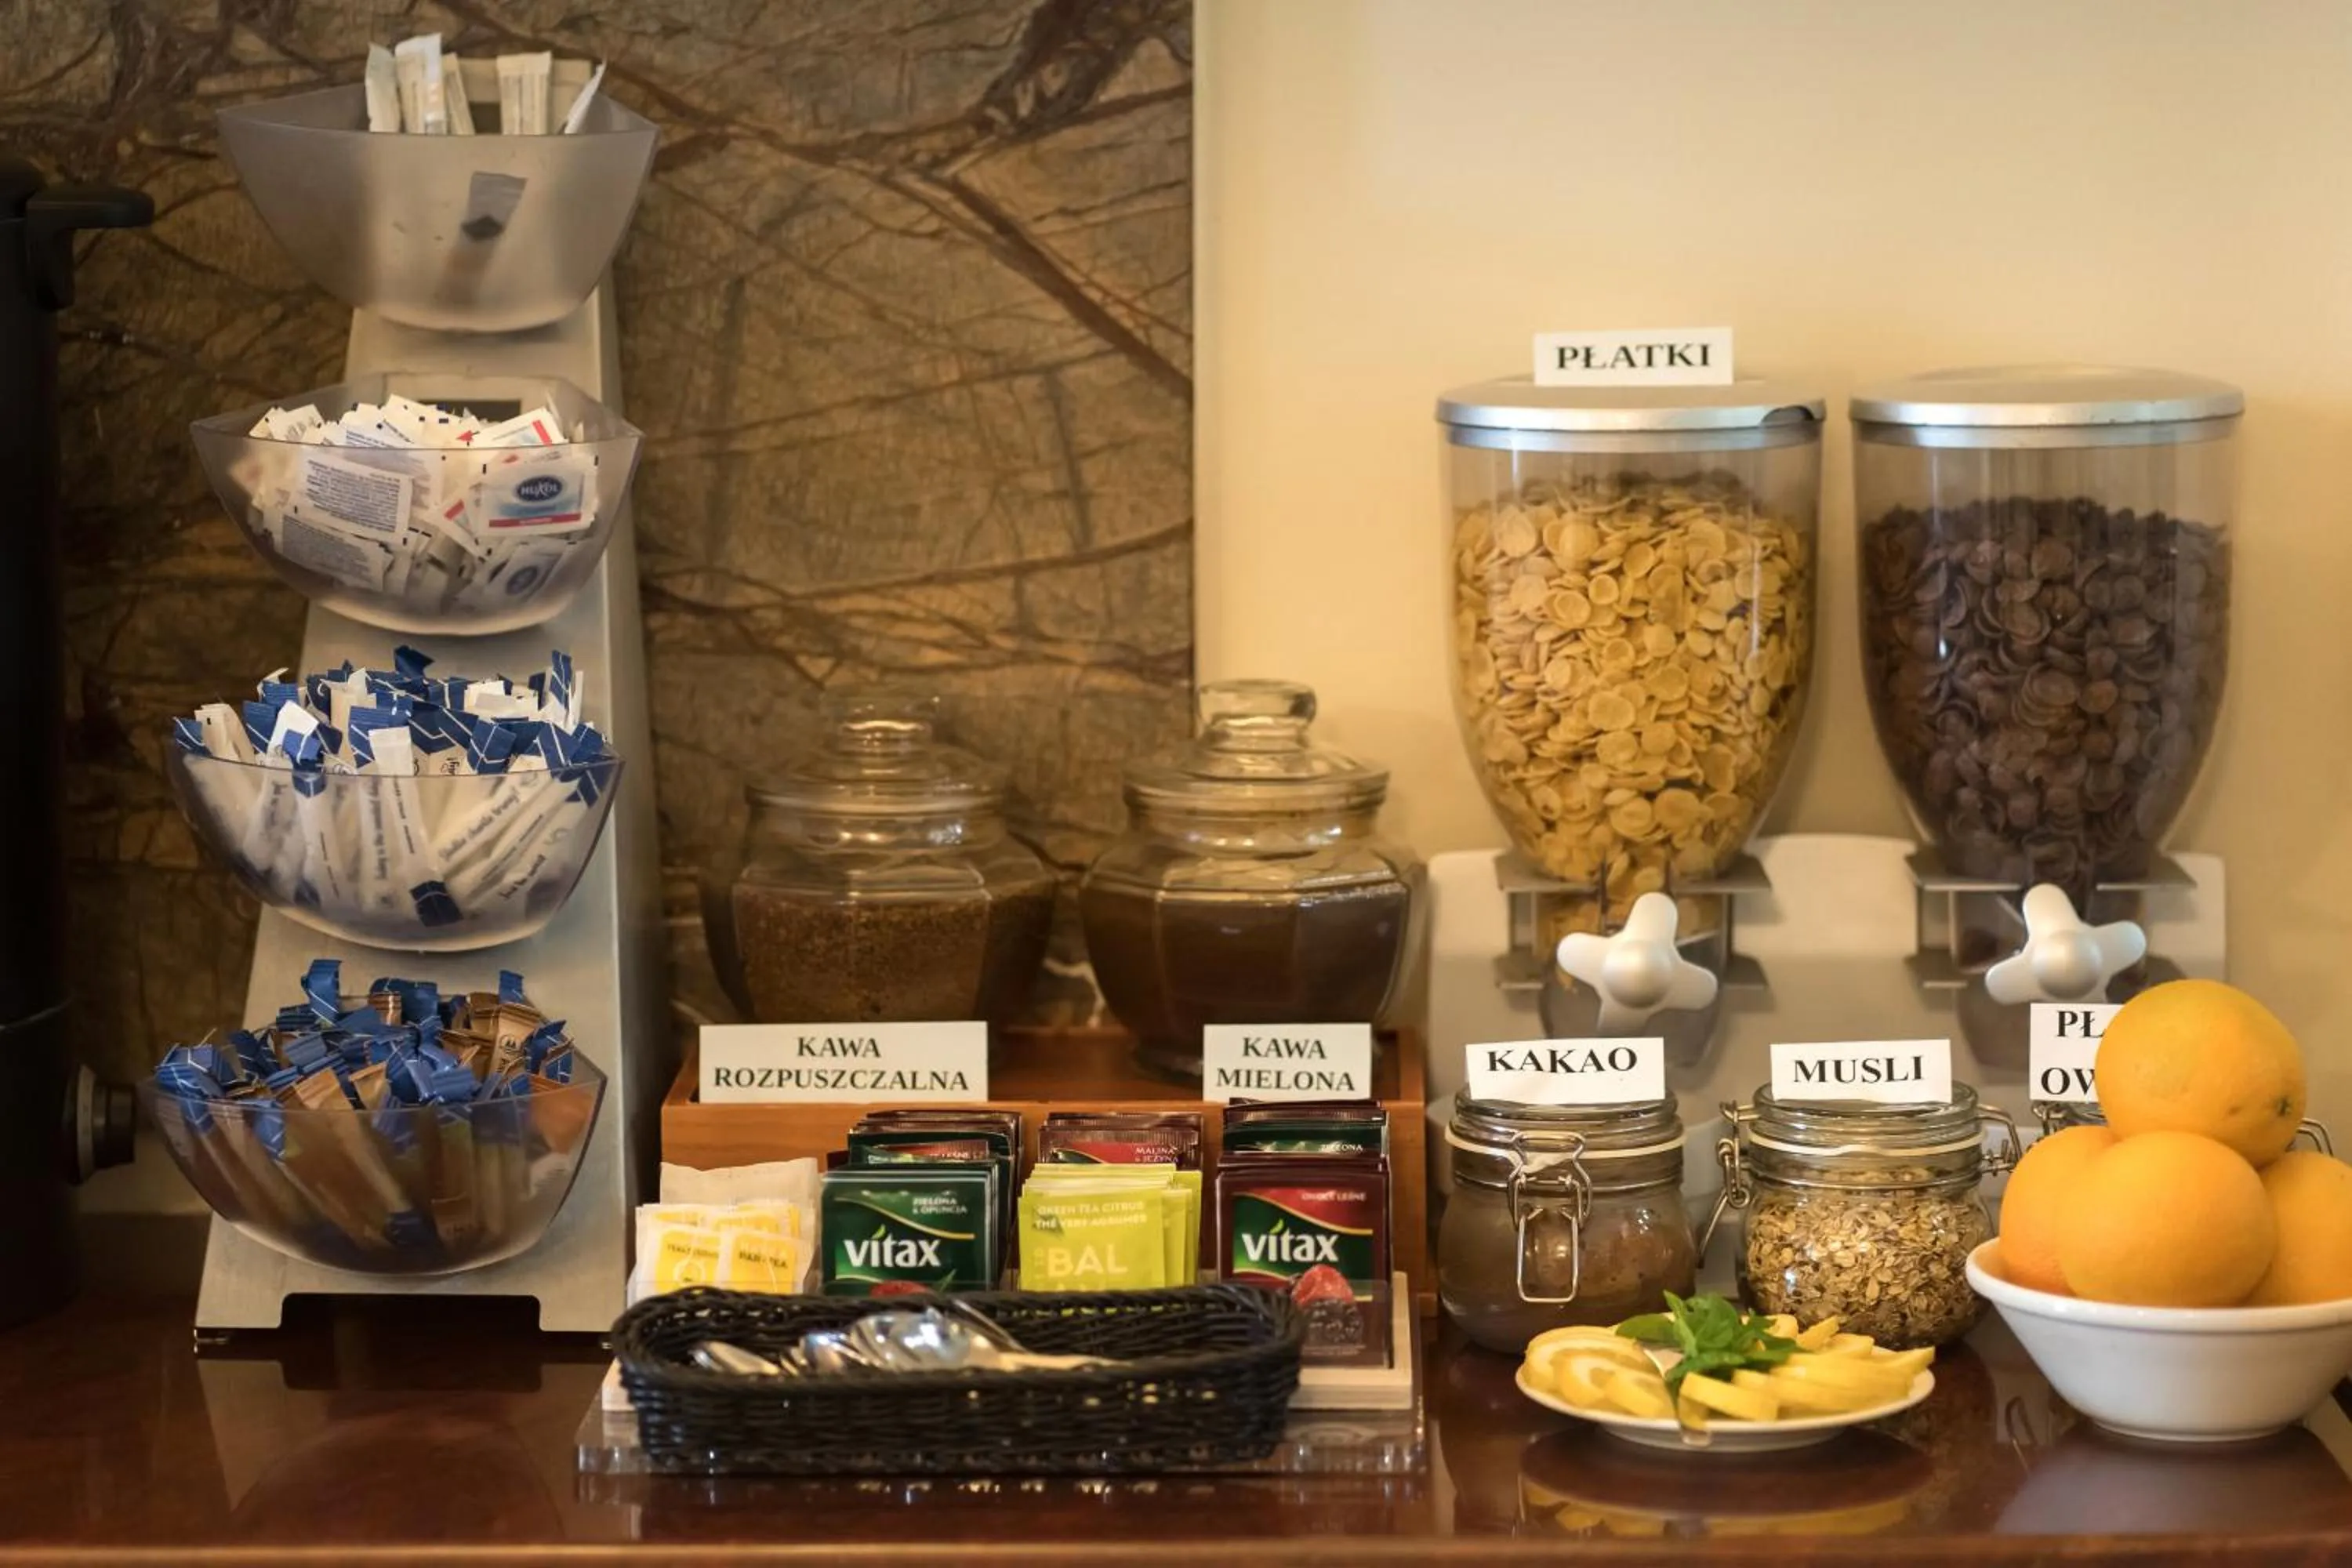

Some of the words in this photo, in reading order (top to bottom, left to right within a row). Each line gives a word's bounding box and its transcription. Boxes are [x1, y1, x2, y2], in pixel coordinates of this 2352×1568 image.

[1556, 343, 1711, 370] PŁATKI
[797, 1036, 882, 1058] KAWA
[1242, 1036, 1327, 1060] KAWA
[1486, 1046, 1638, 1074] KAKAO
[713, 1066, 969, 1091] ROZPUSZCZALNA
[1216, 1067, 1356, 1092] MIELONA
[1792, 1054, 1926, 1084] MUSLI
[1037, 1205, 1076, 1215] GREEN
[1080, 1203, 1100, 1214] TEA
[1102, 1200, 1145, 1213] CITRUS
[843, 1224, 942, 1269] vitax
[1241, 1218, 1339, 1262] vitax
[1047, 1242, 1129, 1278] BAL
